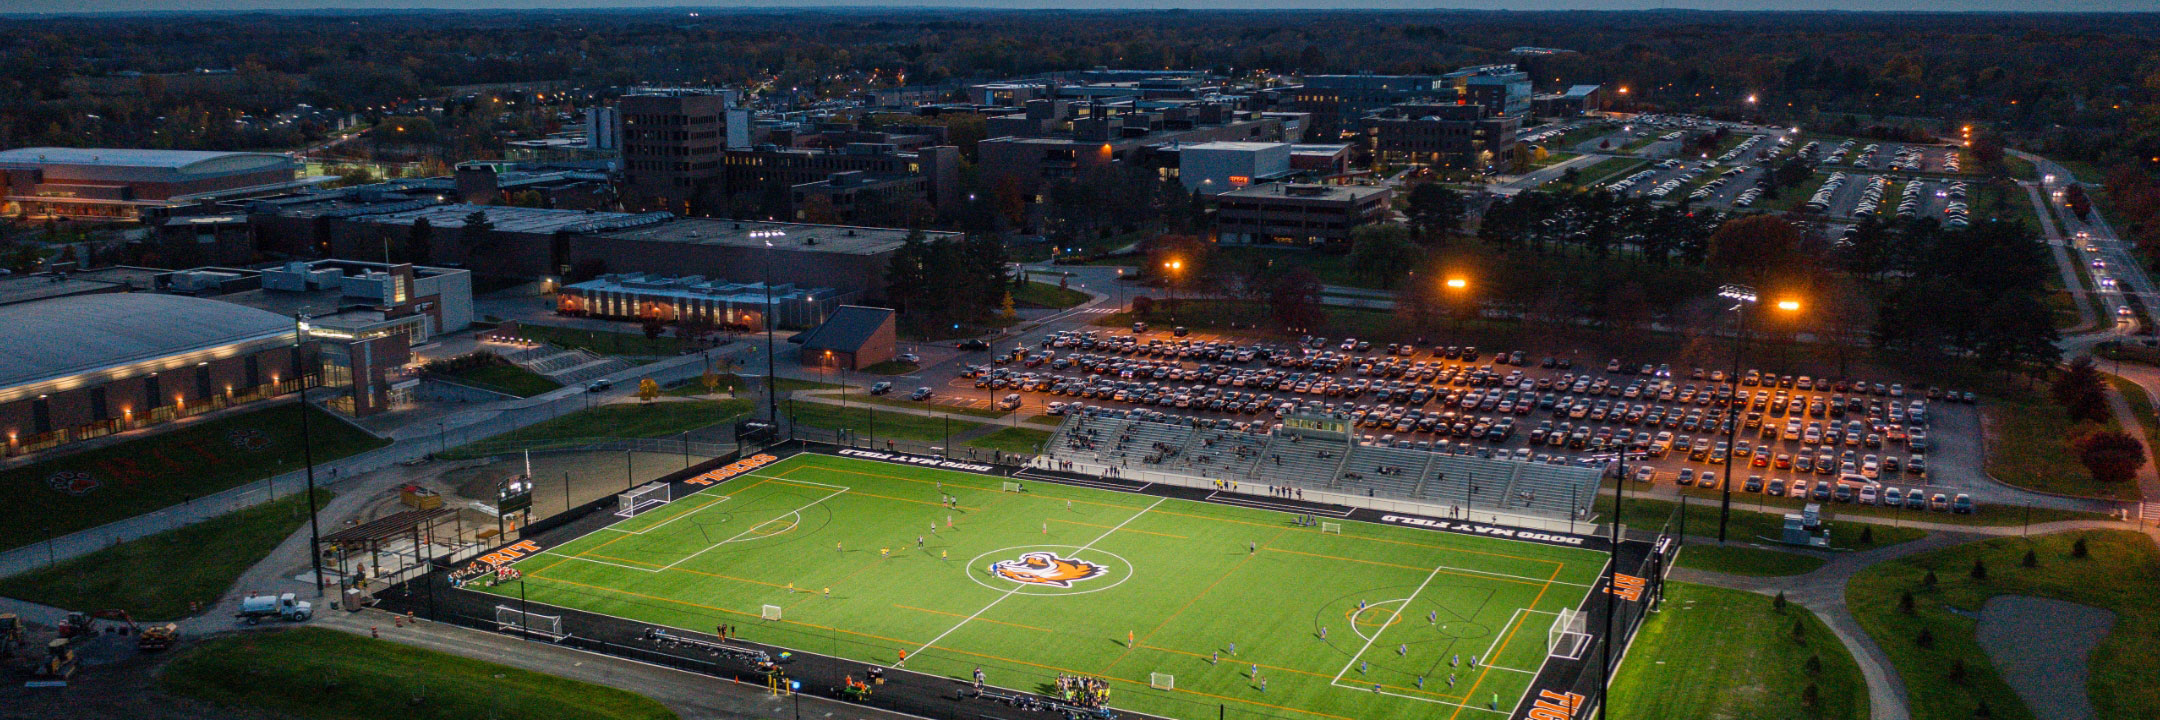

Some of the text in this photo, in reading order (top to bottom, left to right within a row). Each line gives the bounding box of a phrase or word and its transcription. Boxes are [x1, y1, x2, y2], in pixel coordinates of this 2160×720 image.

[683, 453, 778, 485] TIGERS
[838, 449, 894, 460] FIELD
[890, 456, 942, 466] MAY
[1381, 515, 1585, 545] DOUG MAY FIELD
[476, 539, 543, 566] RIT
[1602, 572, 1647, 602] RIT
[1524, 689, 1586, 720] TIG
